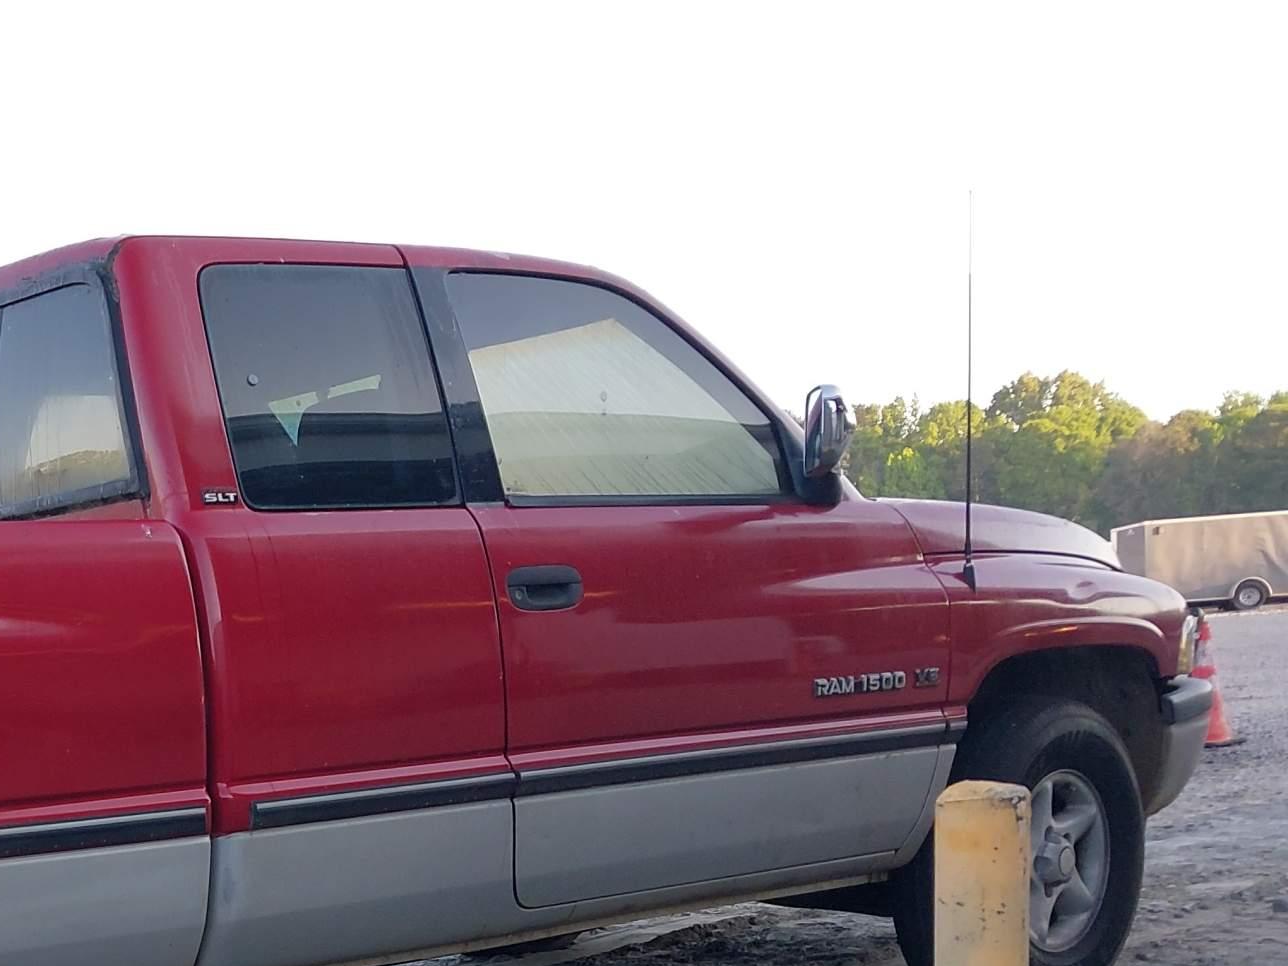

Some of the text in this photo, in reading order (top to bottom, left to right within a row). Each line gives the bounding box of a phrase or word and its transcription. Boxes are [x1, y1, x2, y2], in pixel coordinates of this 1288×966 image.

[204, 492, 237, 503] SLT
[814, 674, 855, 697] RAM
[860, 671, 906, 692] 1500
